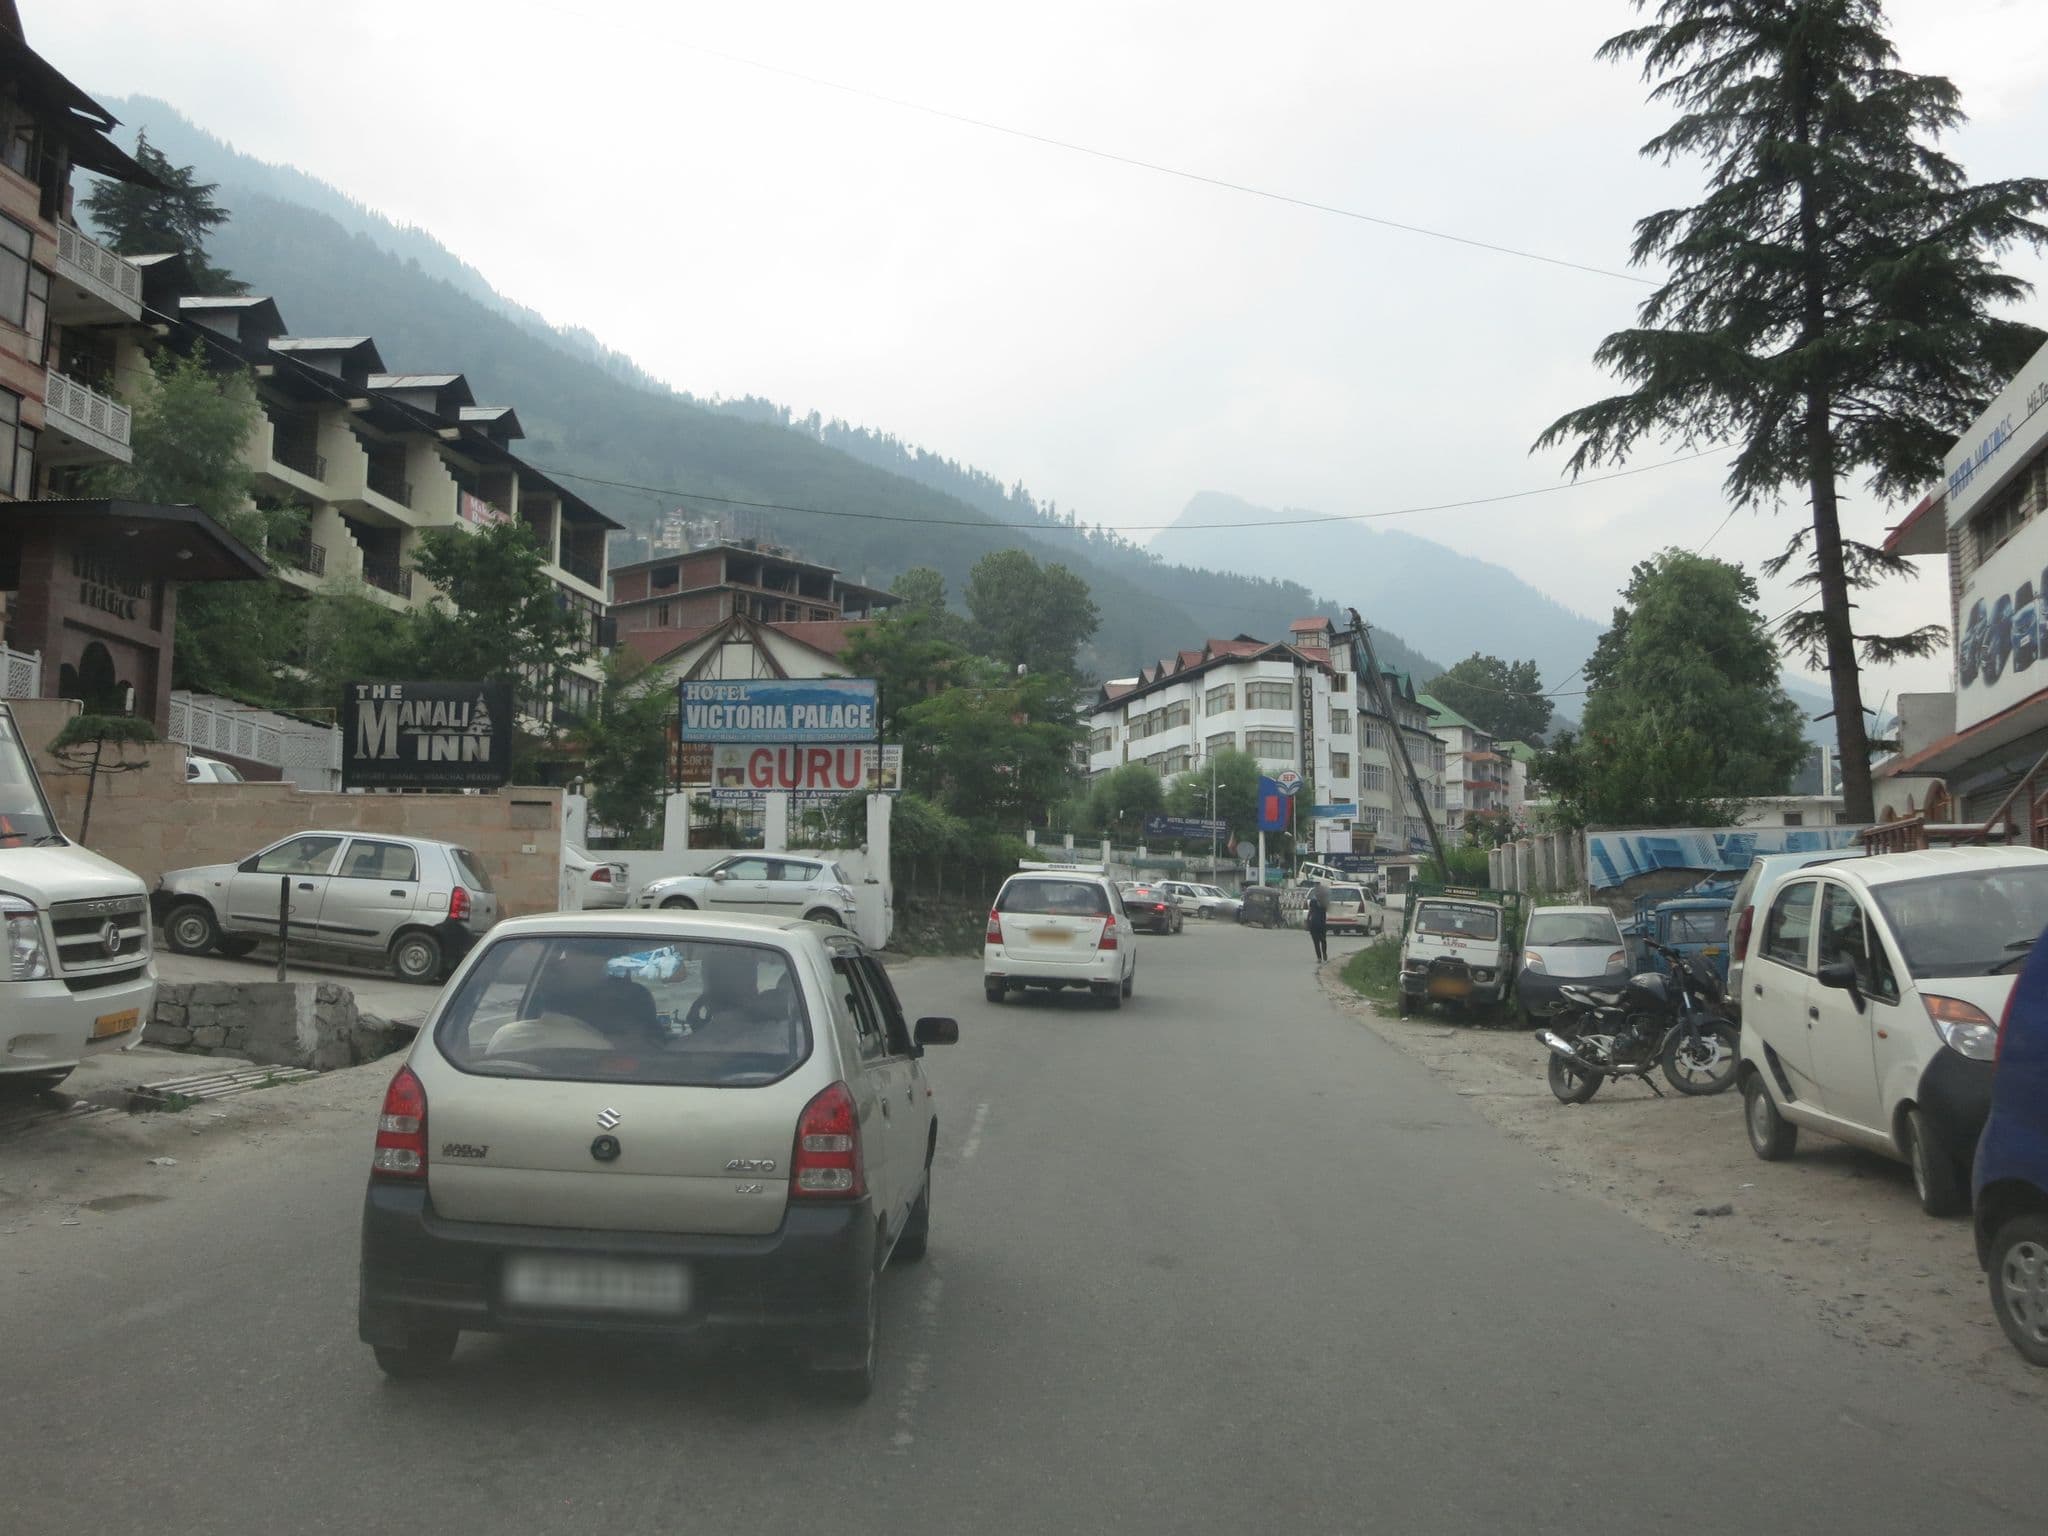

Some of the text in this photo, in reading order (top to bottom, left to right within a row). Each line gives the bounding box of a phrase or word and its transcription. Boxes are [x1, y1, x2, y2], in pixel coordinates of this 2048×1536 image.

[356, 685, 402, 699] THE
[686, 685, 750, 701] HOTEL
[1303, 676, 1313, 730] HOTEL
[687, 704, 871, 730] VICTORIA PALACE
[354, 700, 470, 760] MANALI
[417, 735, 491, 762] INN
[748, 748, 861, 789] GURU
[1282, 774, 1296, 782] HP
[716, 790, 748, 798] Kerala
[725, 1159, 776, 1172] ALTO
